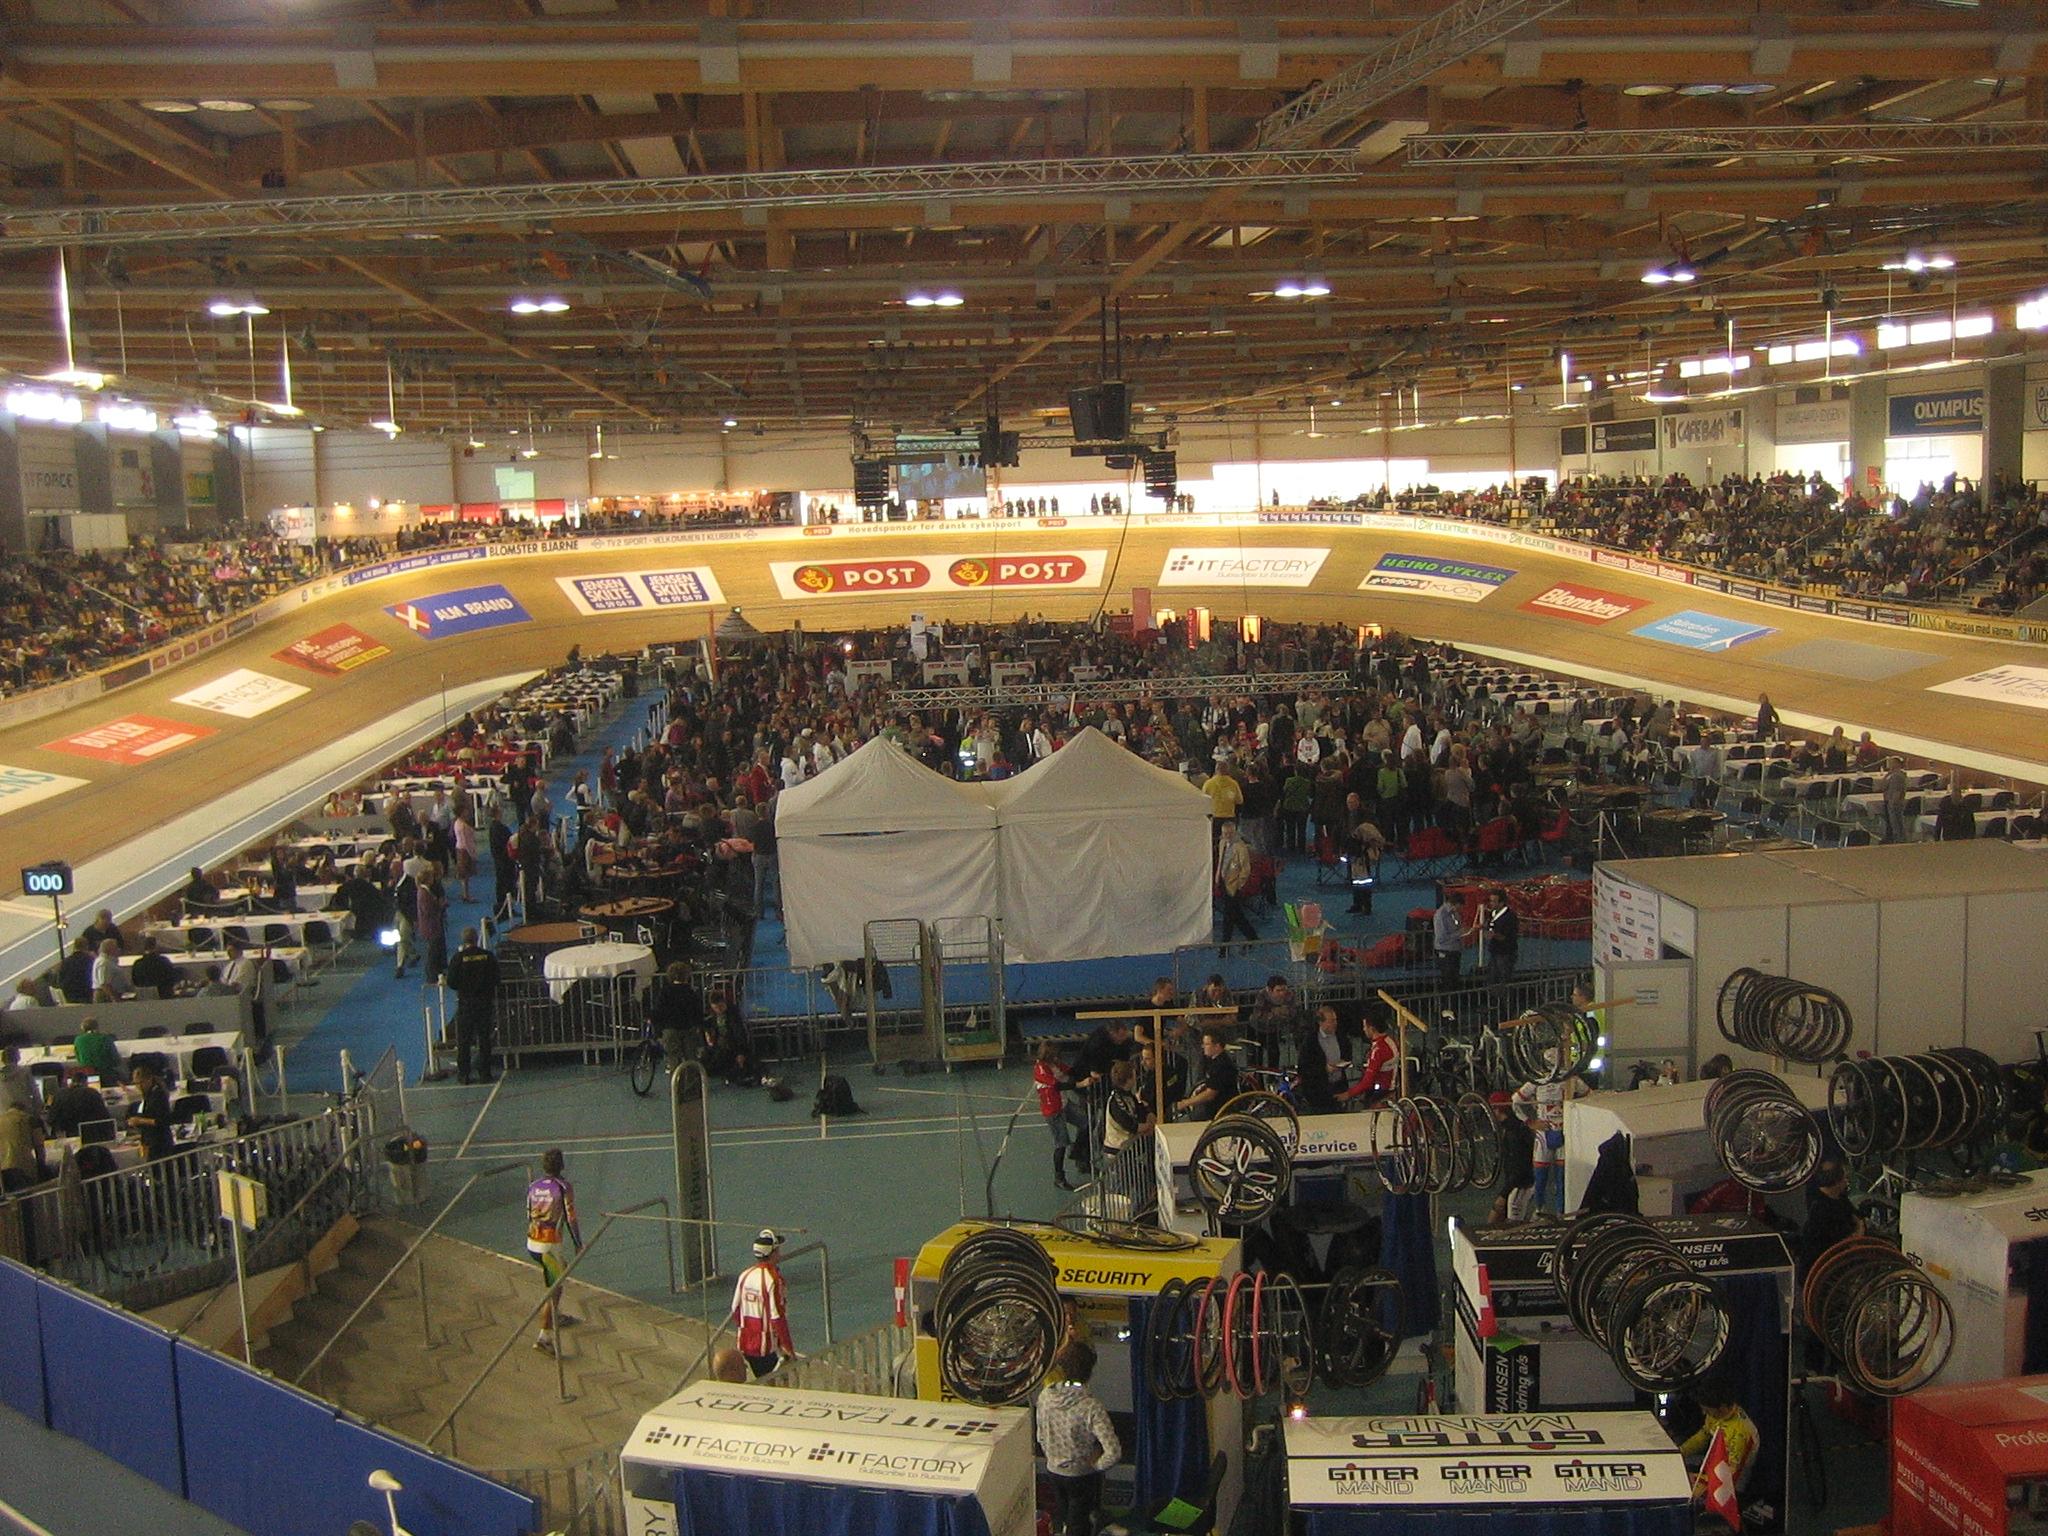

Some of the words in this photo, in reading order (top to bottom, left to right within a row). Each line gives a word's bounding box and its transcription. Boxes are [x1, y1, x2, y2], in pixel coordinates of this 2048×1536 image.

[1914, 396, 1984, 420] OLYMPUS
[920, 522, 935, 531] for
[938, 521, 967, 531] dansk
[489, 543, 538, 557] BLOMSTER
[541, 540, 579, 552] BJARNE
[1000, 562, 1074, 580] POST
[1197, 559, 1219, 571] IT
[1220, 559, 1317, 572] FACTORY
[1382, 558, 1439, 571] HEINO
[1441, 564, 1507, 582] CYKLER
[580, 578, 625, 592] JENSEN
[649, 572, 695, 586] JENSEN
[843, 567, 916, 586] POST
[586, 587, 633, 604] SKILTE
[652, 582, 701, 598] SKILTE
[464, 597, 514, 615] BRAND
[1535, 587, 1631, 619] Blomberg
[69, 722, 155, 749] BUTLER
[29, 874, 63, 891] 000
[1287, 1140, 1358, 1154] service
[1708, 1255, 1729, 1267] a/s
[1061, 1268, 1153, 1287] SECURITY
[1516, 1354, 1529, 1375] a/s
[678, 1396, 890, 1425] FACTORY
[891, 1415, 940, 1428] IT
[1368, 1414, 1576, 1434] MAND
[672, 1434, 696, 1448] IT
[696, 1436, 804, 1459] FACTORY
[836, 1450, 861, 1465] IT
[862, 1453, 973, 1475] FACTORY
[1563, 1475, 1643, 1492] MAND
[1897, 1461, 1926, 1492] BUTLER
[1336, 1479, 1415, 1495] MAND
[1449, 1478, 1529, 1494] MAND
[1928, 1486, 1960, 1518] BUTLER
